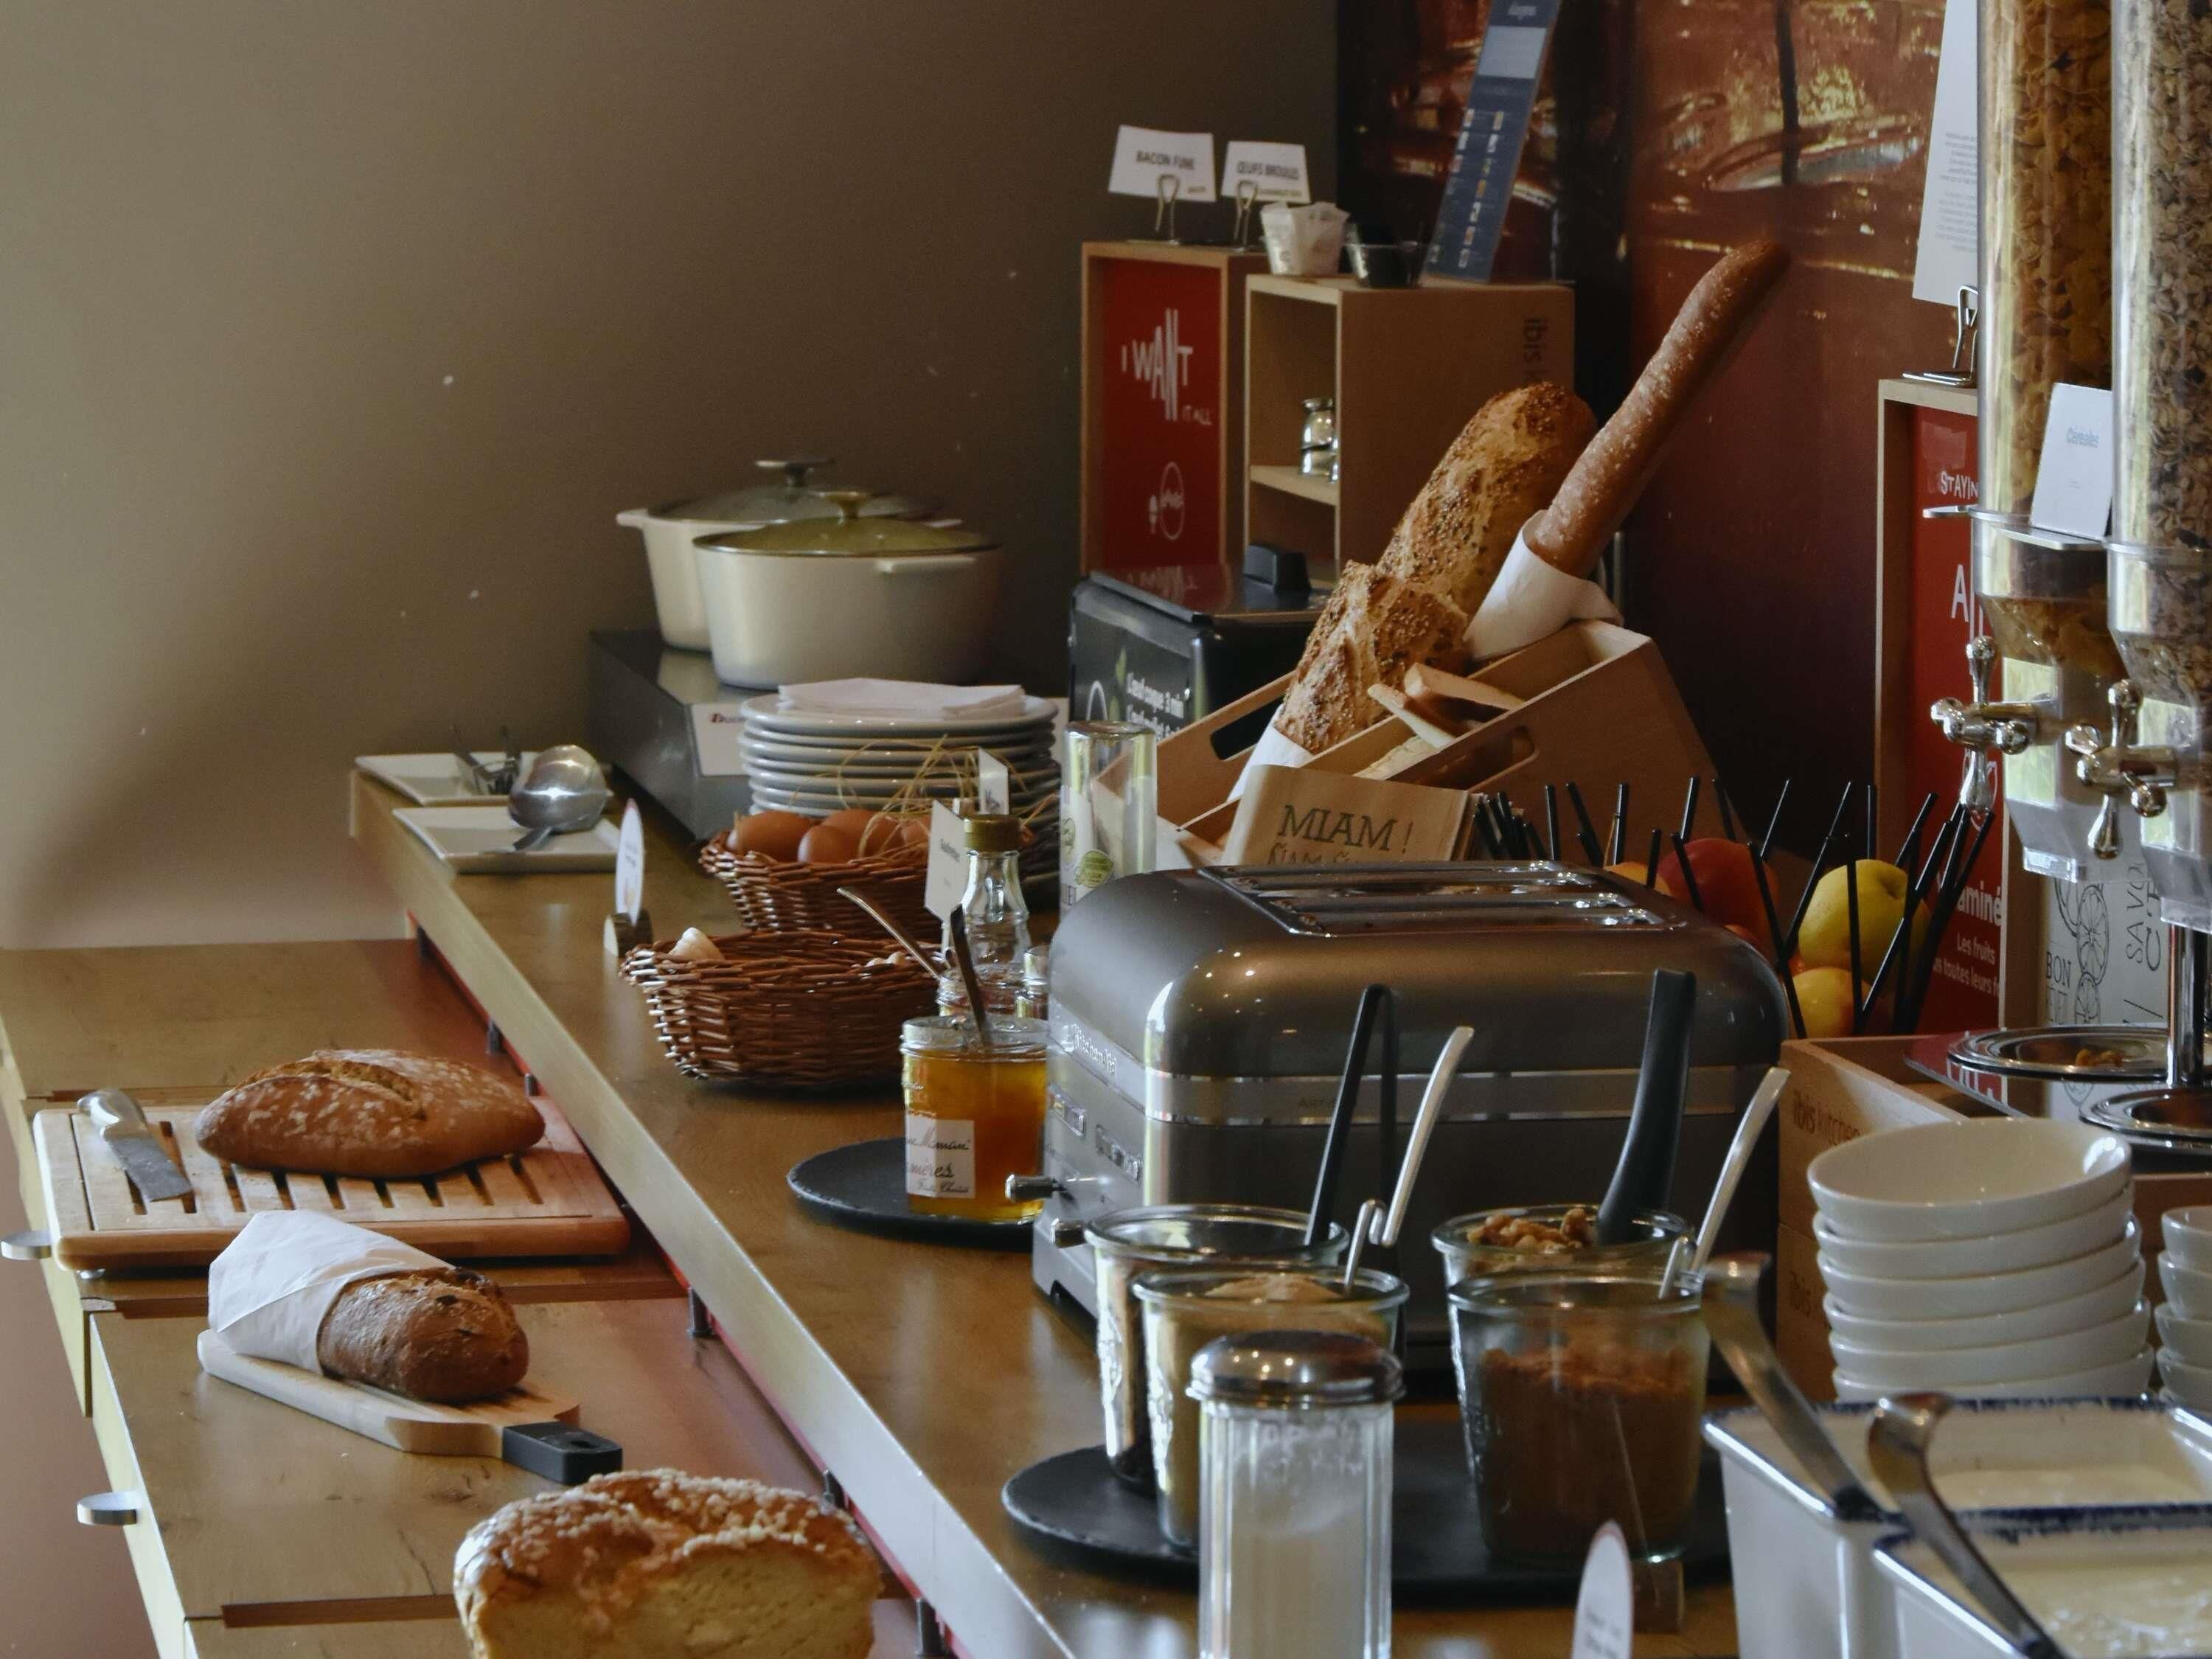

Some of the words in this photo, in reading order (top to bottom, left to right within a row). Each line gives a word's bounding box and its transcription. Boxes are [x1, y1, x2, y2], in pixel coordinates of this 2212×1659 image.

[1136, 150, 1170, 166] BACON
[1121, 344, 1128, 372] I
[1131, 307, 1194, 422] WANT
[1277, 804, 1399, 851] MIAM
[1957, 932, 1970, 955] Les
[1973, 936, 1995, 965] fruits
[1971, 966, 1992, 994] leurs
[2046, 951, 2071, 988] BON
